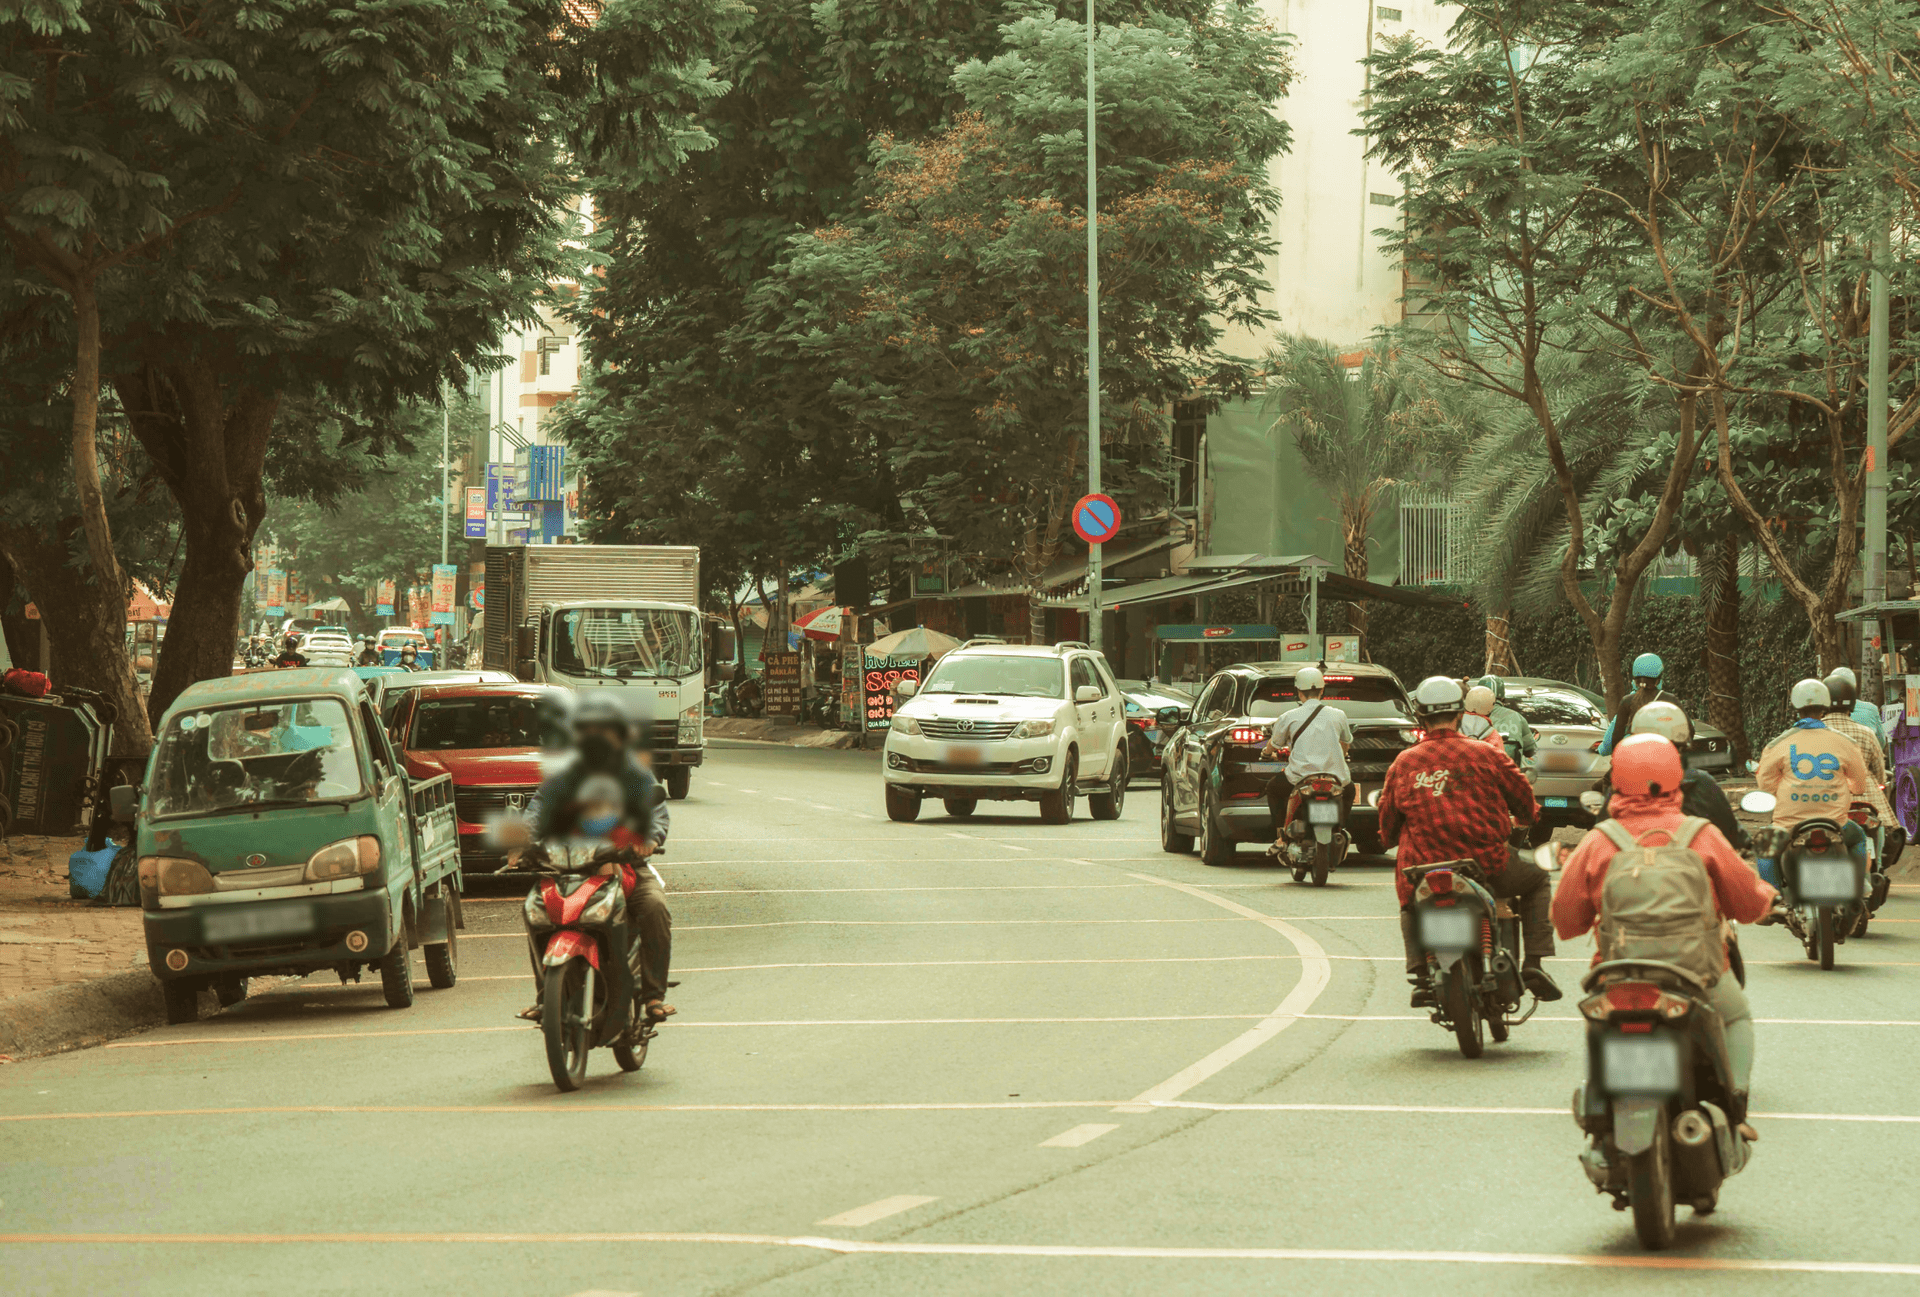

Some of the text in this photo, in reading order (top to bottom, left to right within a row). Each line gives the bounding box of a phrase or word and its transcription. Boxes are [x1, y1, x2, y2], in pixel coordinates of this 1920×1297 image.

[767, 654, 799, 666] CÀ PHÊ
[867, 694, 884, 706] GIỜ
[868, 707, 885, 718] GIỜ
[1790, 744, 1840, 780] be
